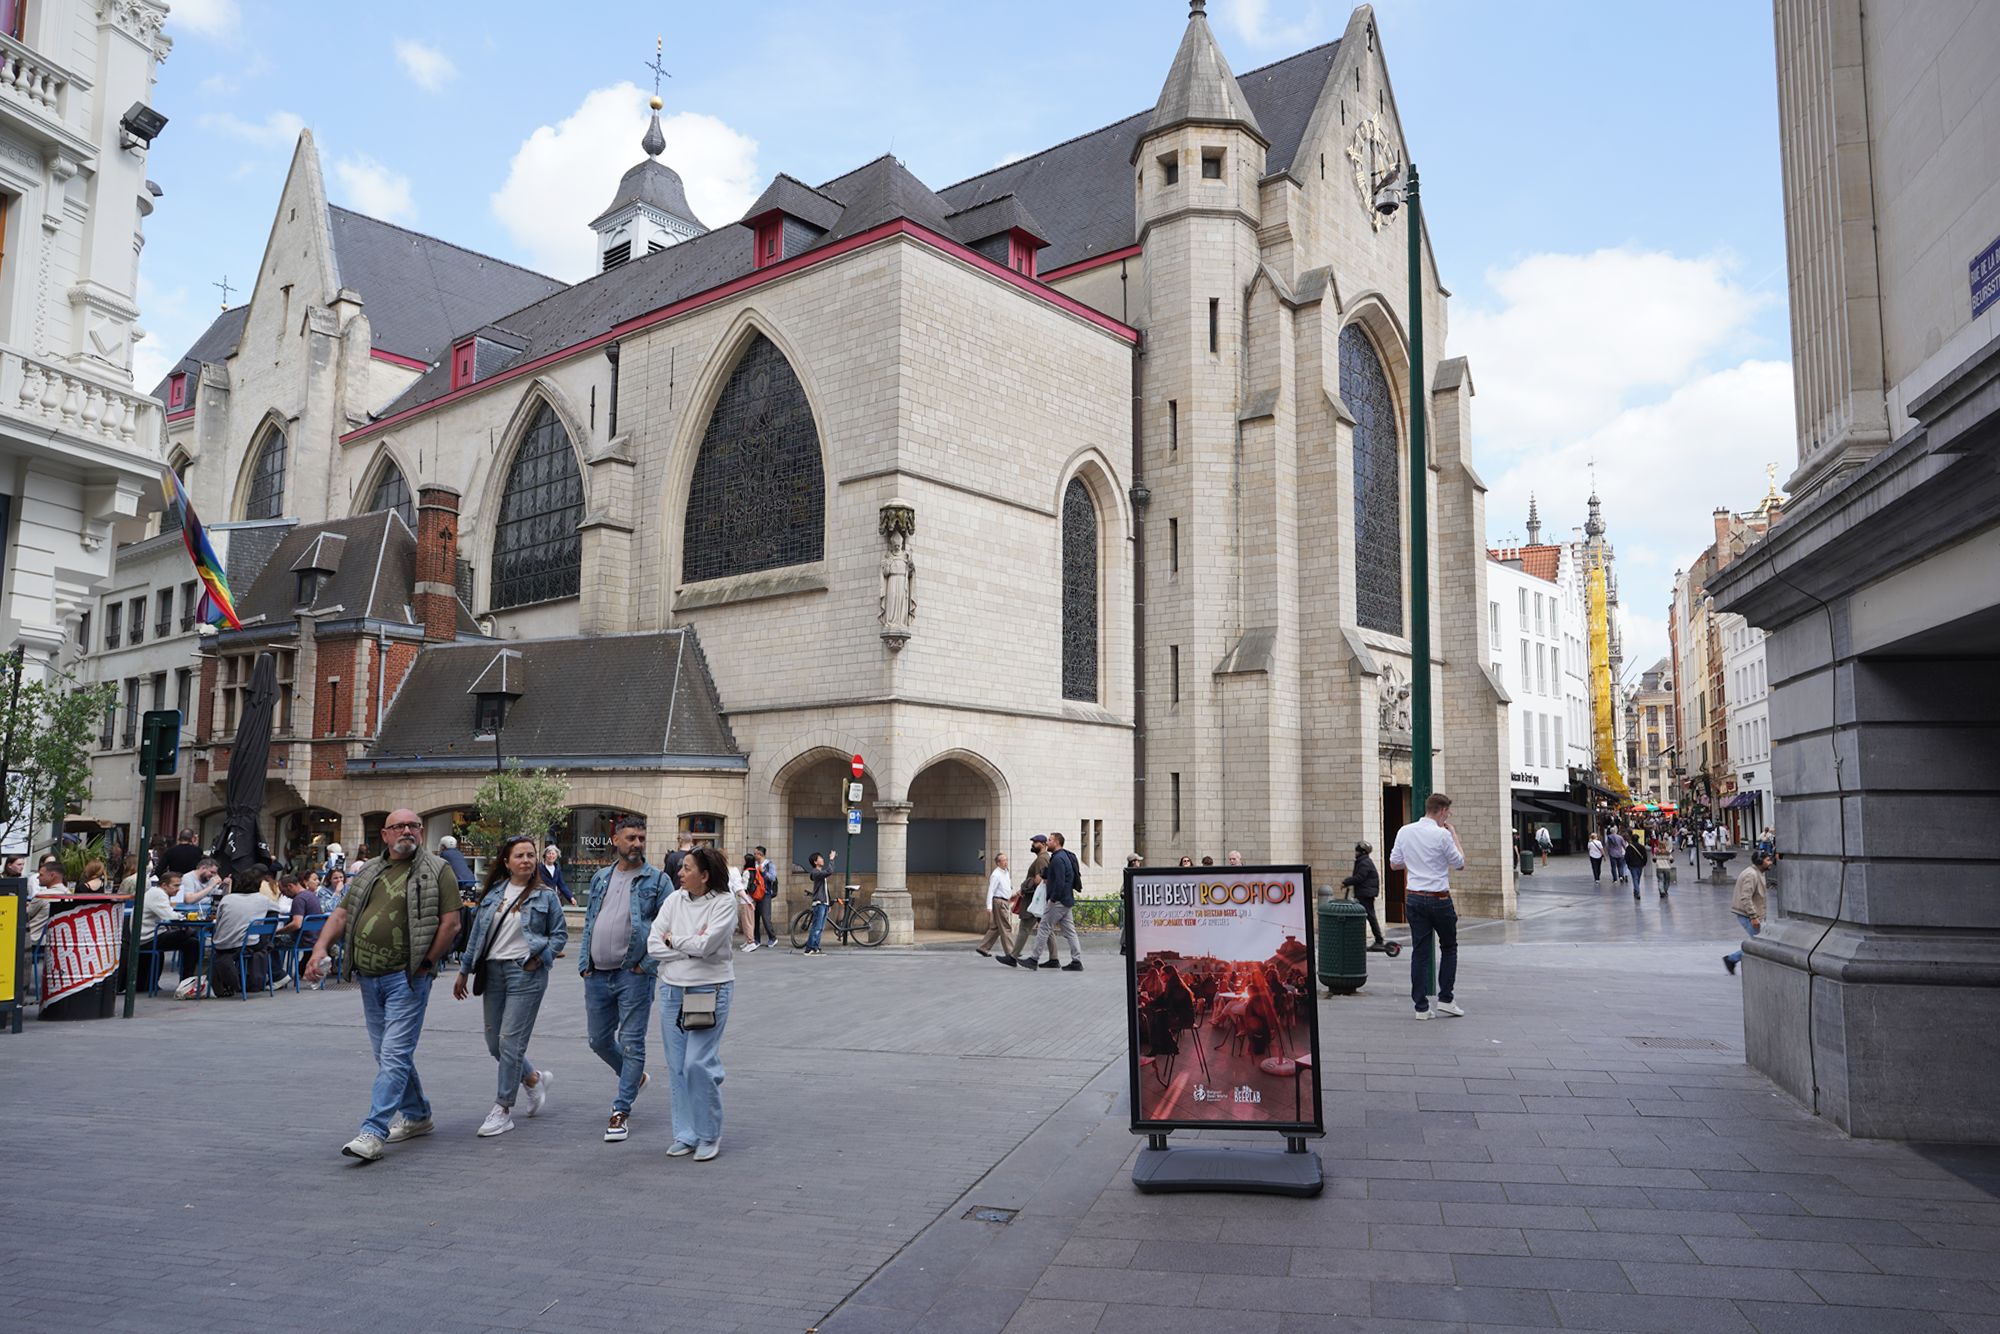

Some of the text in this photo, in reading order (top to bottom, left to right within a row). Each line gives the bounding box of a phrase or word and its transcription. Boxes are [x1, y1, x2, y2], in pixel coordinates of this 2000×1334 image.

[580, 836, 613, 847] TEQULA
[1137, 881, 1295, 905] THE BEST ROOFTOP
